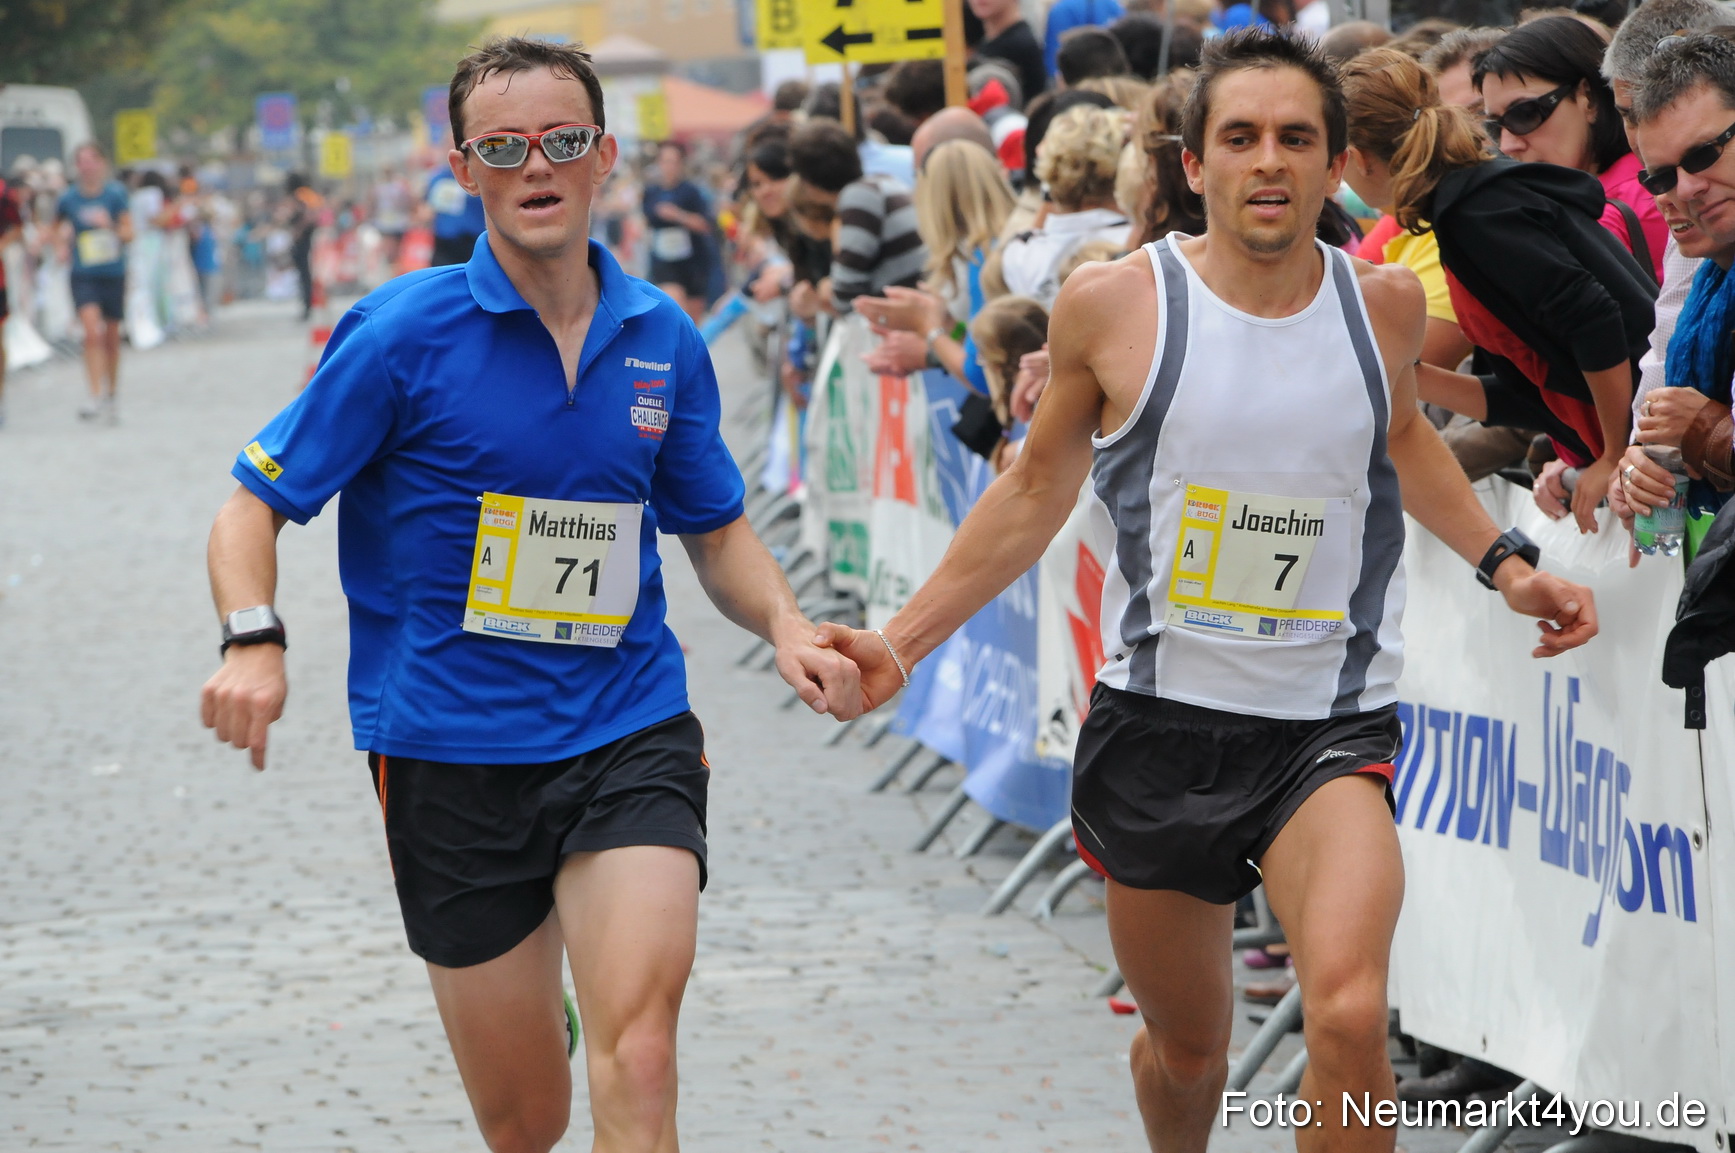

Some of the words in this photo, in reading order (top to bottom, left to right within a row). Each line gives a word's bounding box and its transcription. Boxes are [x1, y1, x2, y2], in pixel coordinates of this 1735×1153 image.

[624, 357, 672, 372] newline
[637, 396, 663, 408] QUELLE
[528, 509, 617, 542] Matthias
[1231, 504, 1325, 537] Joachim
[481, 546, 492, 566] A
[1183, 539, 1195, 559] A
[554, 557, 601, 597] 71
[1273, 553, 1299, 591] 7
[483, 616, 531, 632] BOCK
[1185, 609, 1233, 625] BOCK
